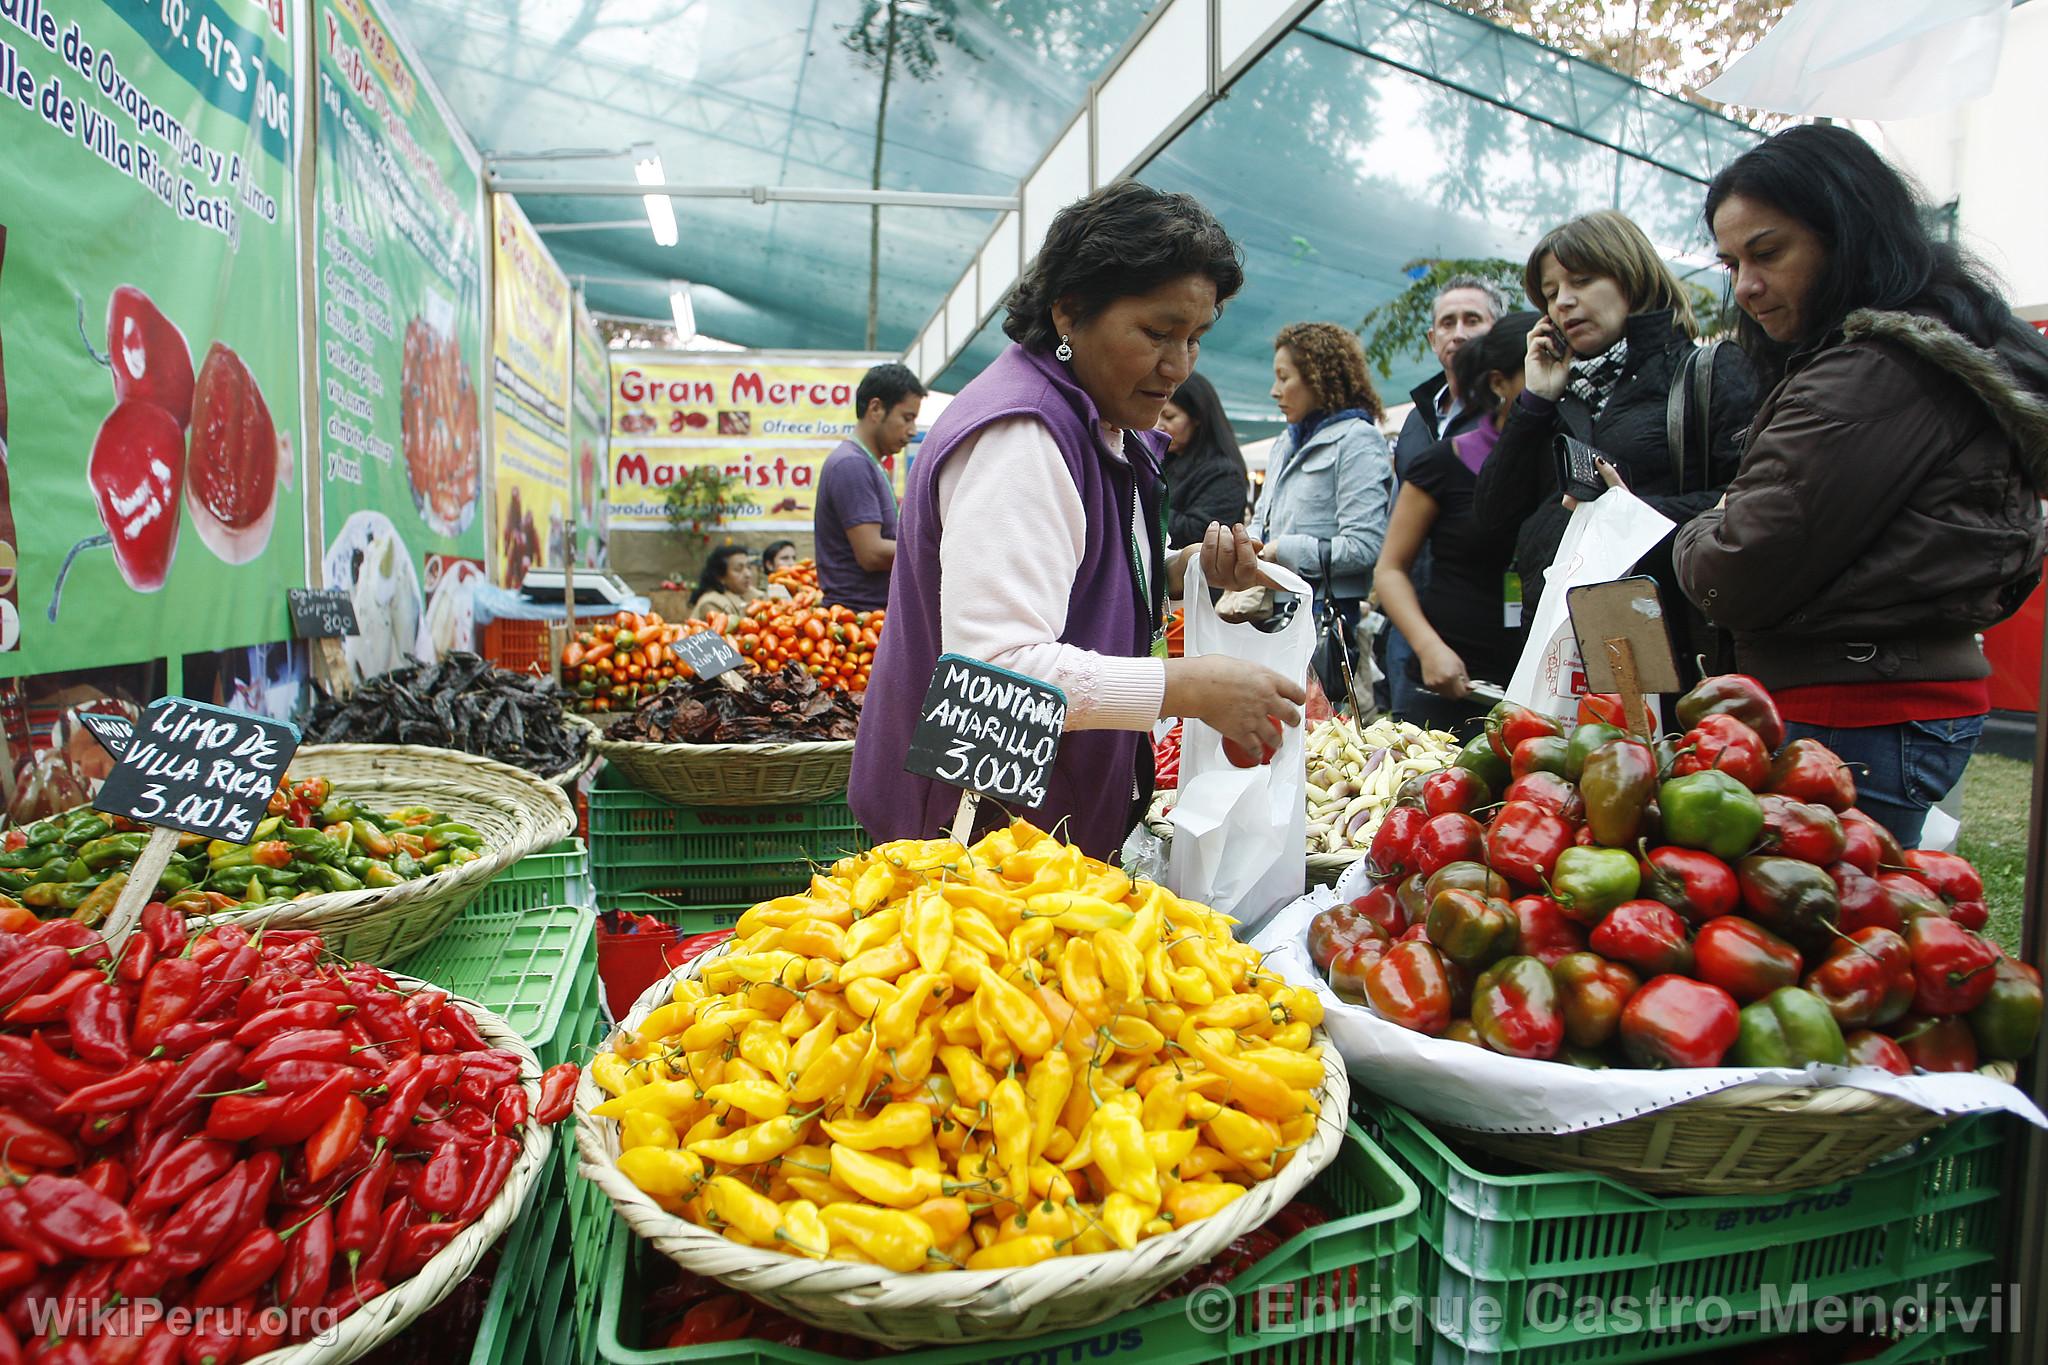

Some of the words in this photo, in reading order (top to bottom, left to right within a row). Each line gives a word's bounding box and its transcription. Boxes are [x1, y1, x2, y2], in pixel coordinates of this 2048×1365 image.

[196, 14, 248, 93] 473
[63, 23, 93, 79] de
[97, 53, 202, 168] Oxapampa
[207, 151, 222, 183] y
[41, 79, 75, 134] de
[80, 101, 132, 173] Villa
[137, 145, 173, 204] Rica
[620, 371, 715, 403] Gran
[763, 419, 812, 435] Ofrece
[816, 420, 838, 435] los
[616, 453, 812, 487] Marista
[942, 663, 1067, 738] MONTAÑA
[124, 738, 200, 781] VILLA
[204, 758, 275, 800] RICA
[230, 725, 279, 771] DE
